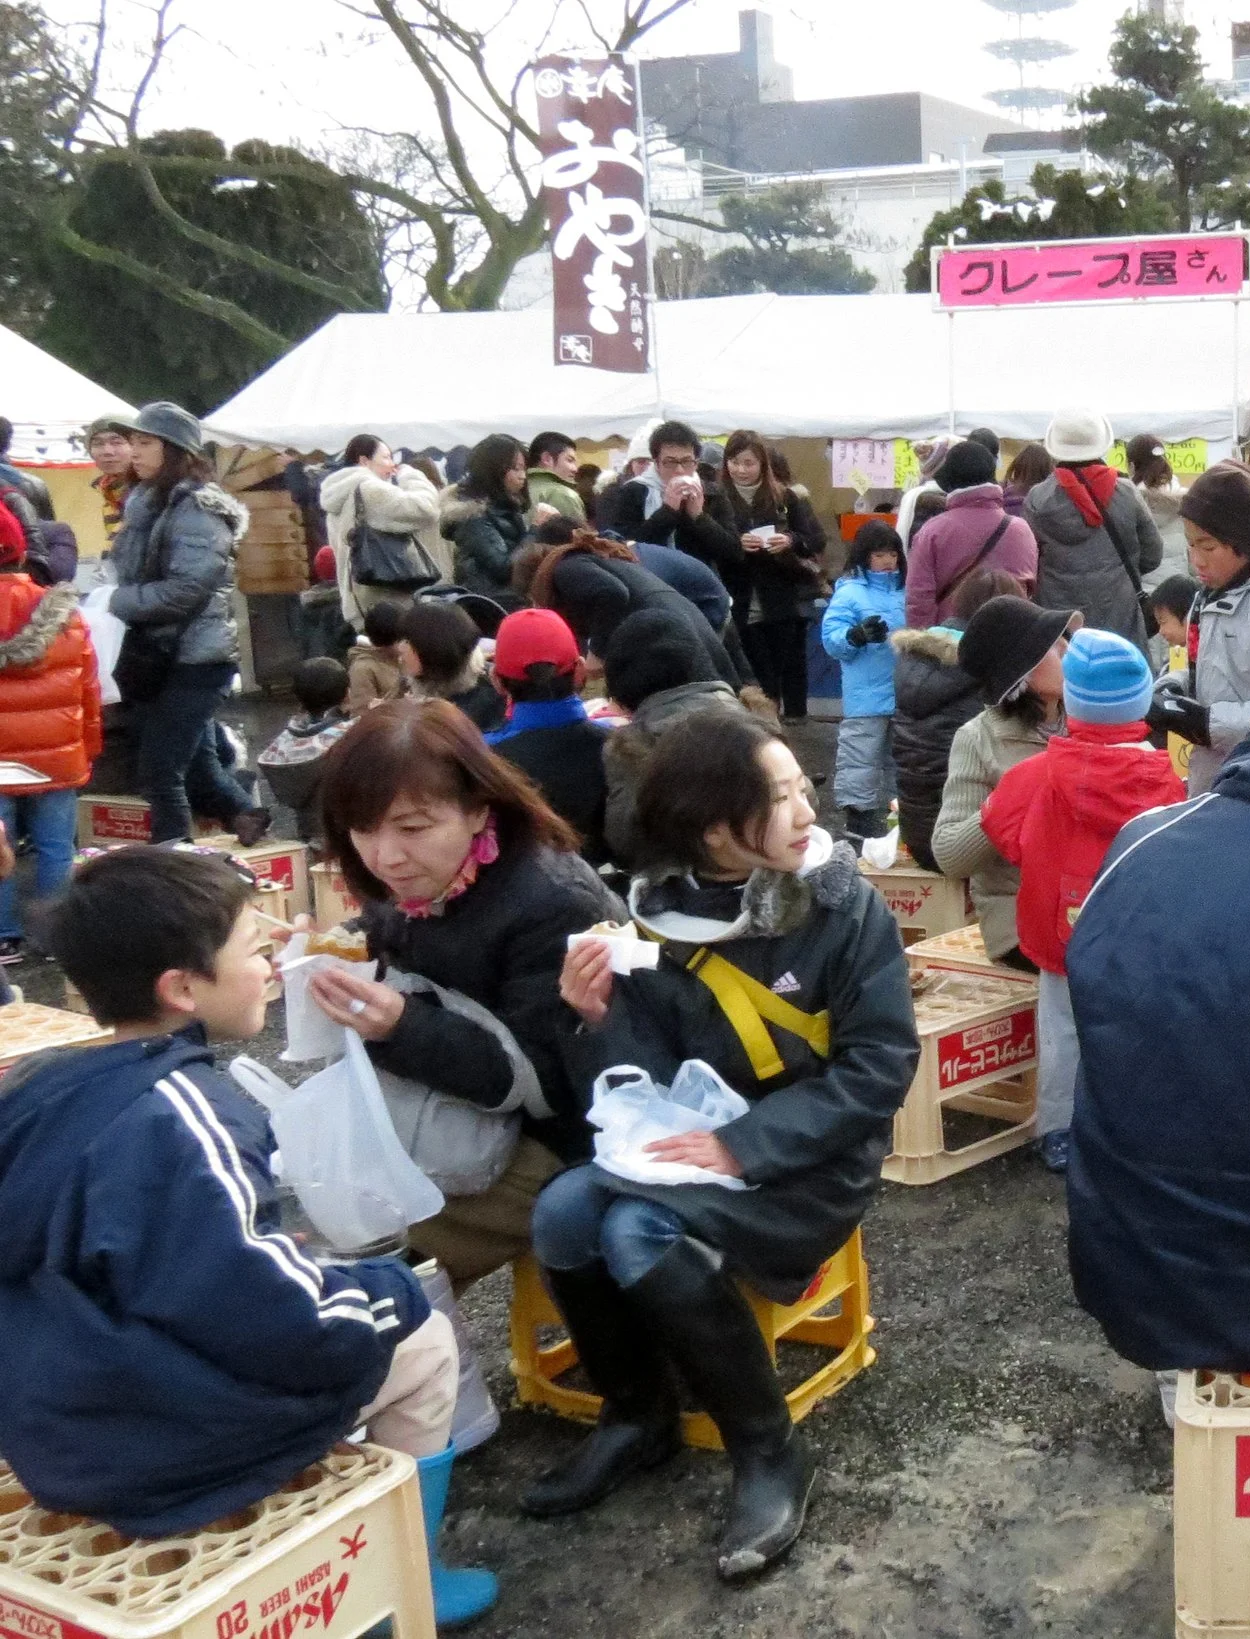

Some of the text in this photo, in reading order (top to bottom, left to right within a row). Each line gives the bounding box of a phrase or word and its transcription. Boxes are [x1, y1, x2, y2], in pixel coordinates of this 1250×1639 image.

[542, 119, 645, 335] おやき
[958, 249, 1228, 296] クレープ屋さん
[941, 1031, 1034, 1082] アサヒビール
[338, 1523, 368, 1560] 大
[259, 1560, 332, 1619] ASAHI BEER
[215, 1599, 249, 1639] 20
